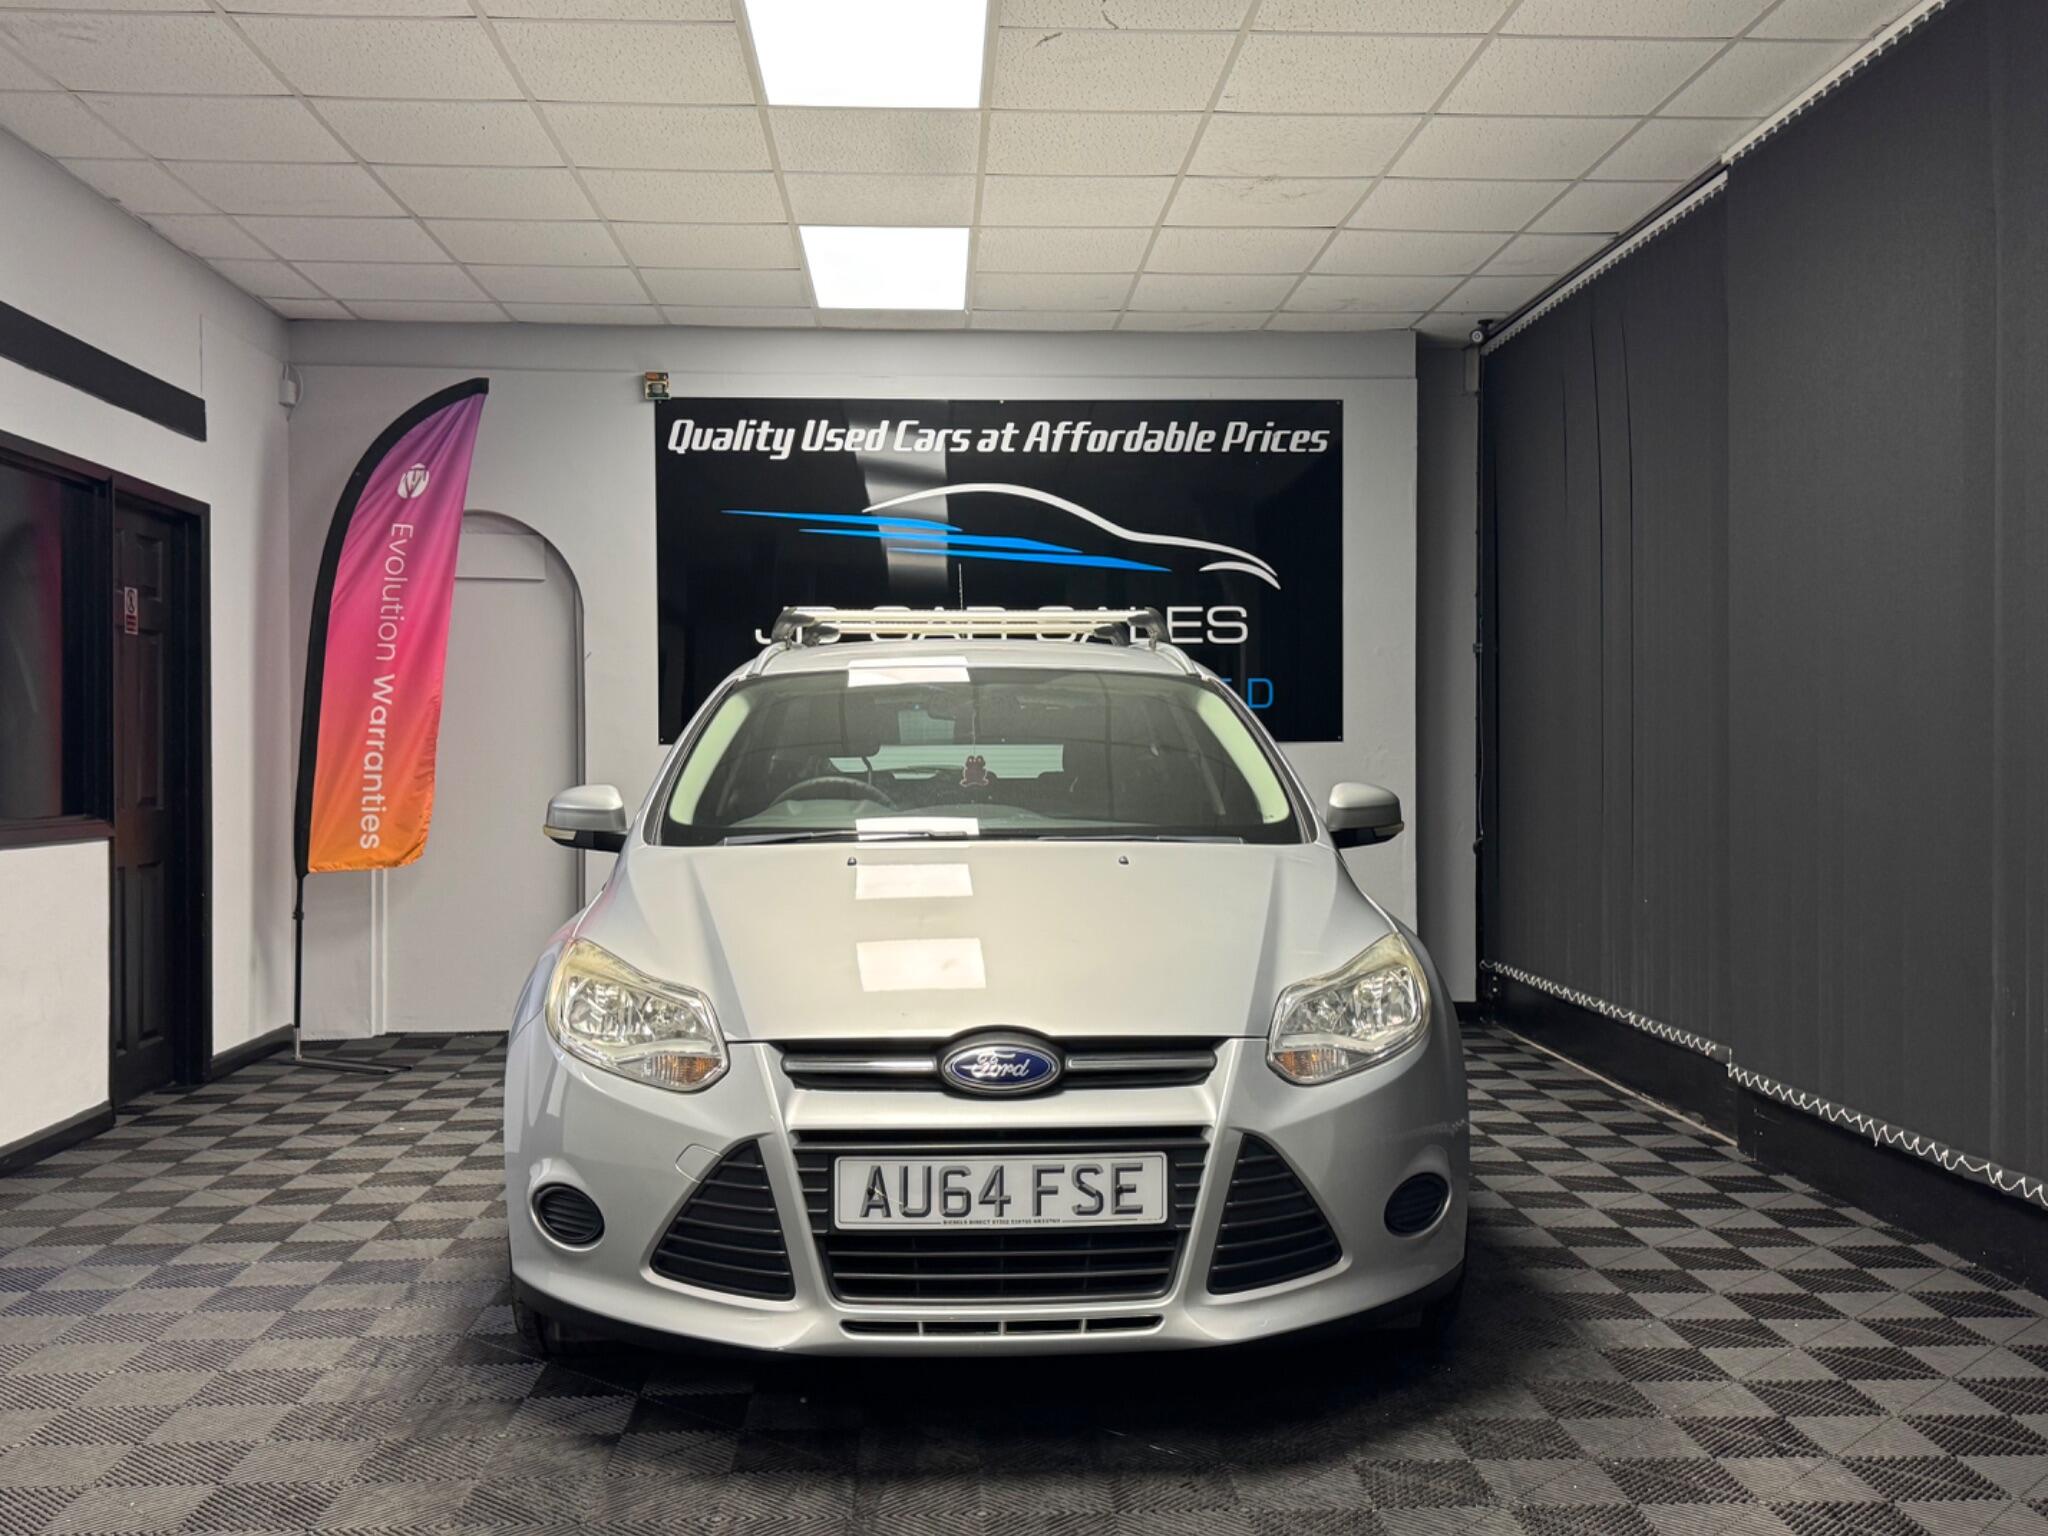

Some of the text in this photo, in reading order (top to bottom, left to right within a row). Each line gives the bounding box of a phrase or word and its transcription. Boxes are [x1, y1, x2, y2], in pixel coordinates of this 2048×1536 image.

[668, 419, 1331, 460] Quality Used Cars at Affordable Prices
[359, 522, 414, 850] Evolution Warranties
[960, 1050, 1031, 1079] Ford
[859, 1162, 1144, 1219] AU64 FSE
